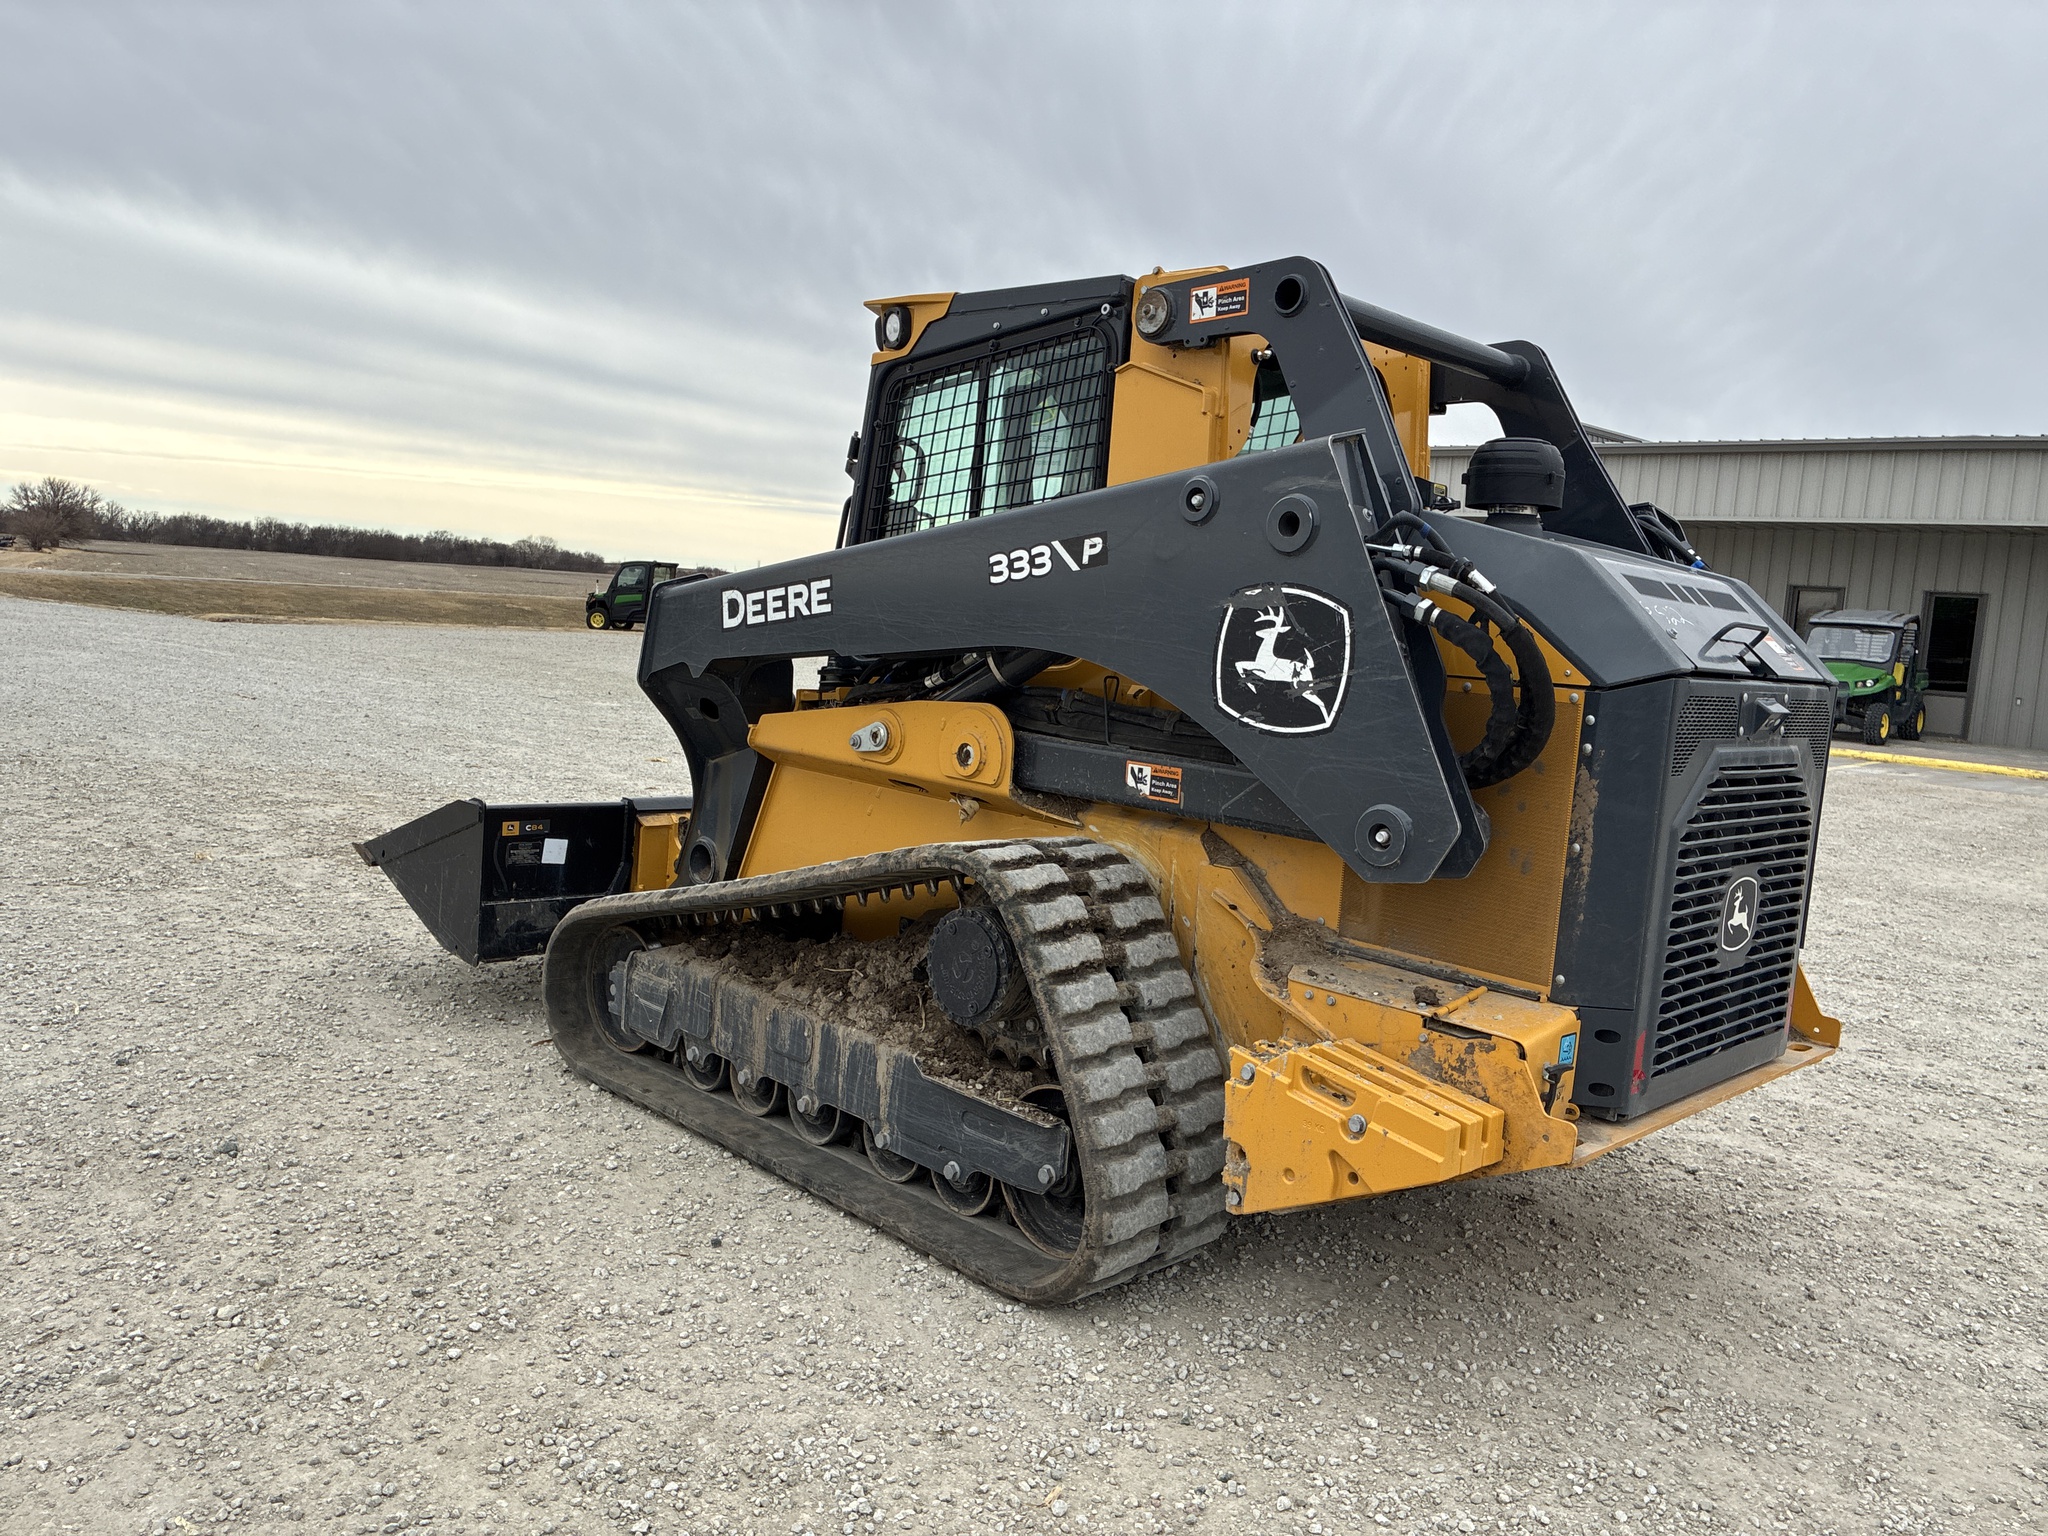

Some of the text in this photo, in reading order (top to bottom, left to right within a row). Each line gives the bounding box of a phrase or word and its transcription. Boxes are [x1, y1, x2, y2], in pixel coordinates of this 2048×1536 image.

[1217, 296, 1232, 305] Pinch
[1217, 304, 1229, 312] Keep
[721, 578, 833, 630] DEERE
[1151, 779, 1177, 789] Pinch Area
[1162, 788, 1173, 796] Away
